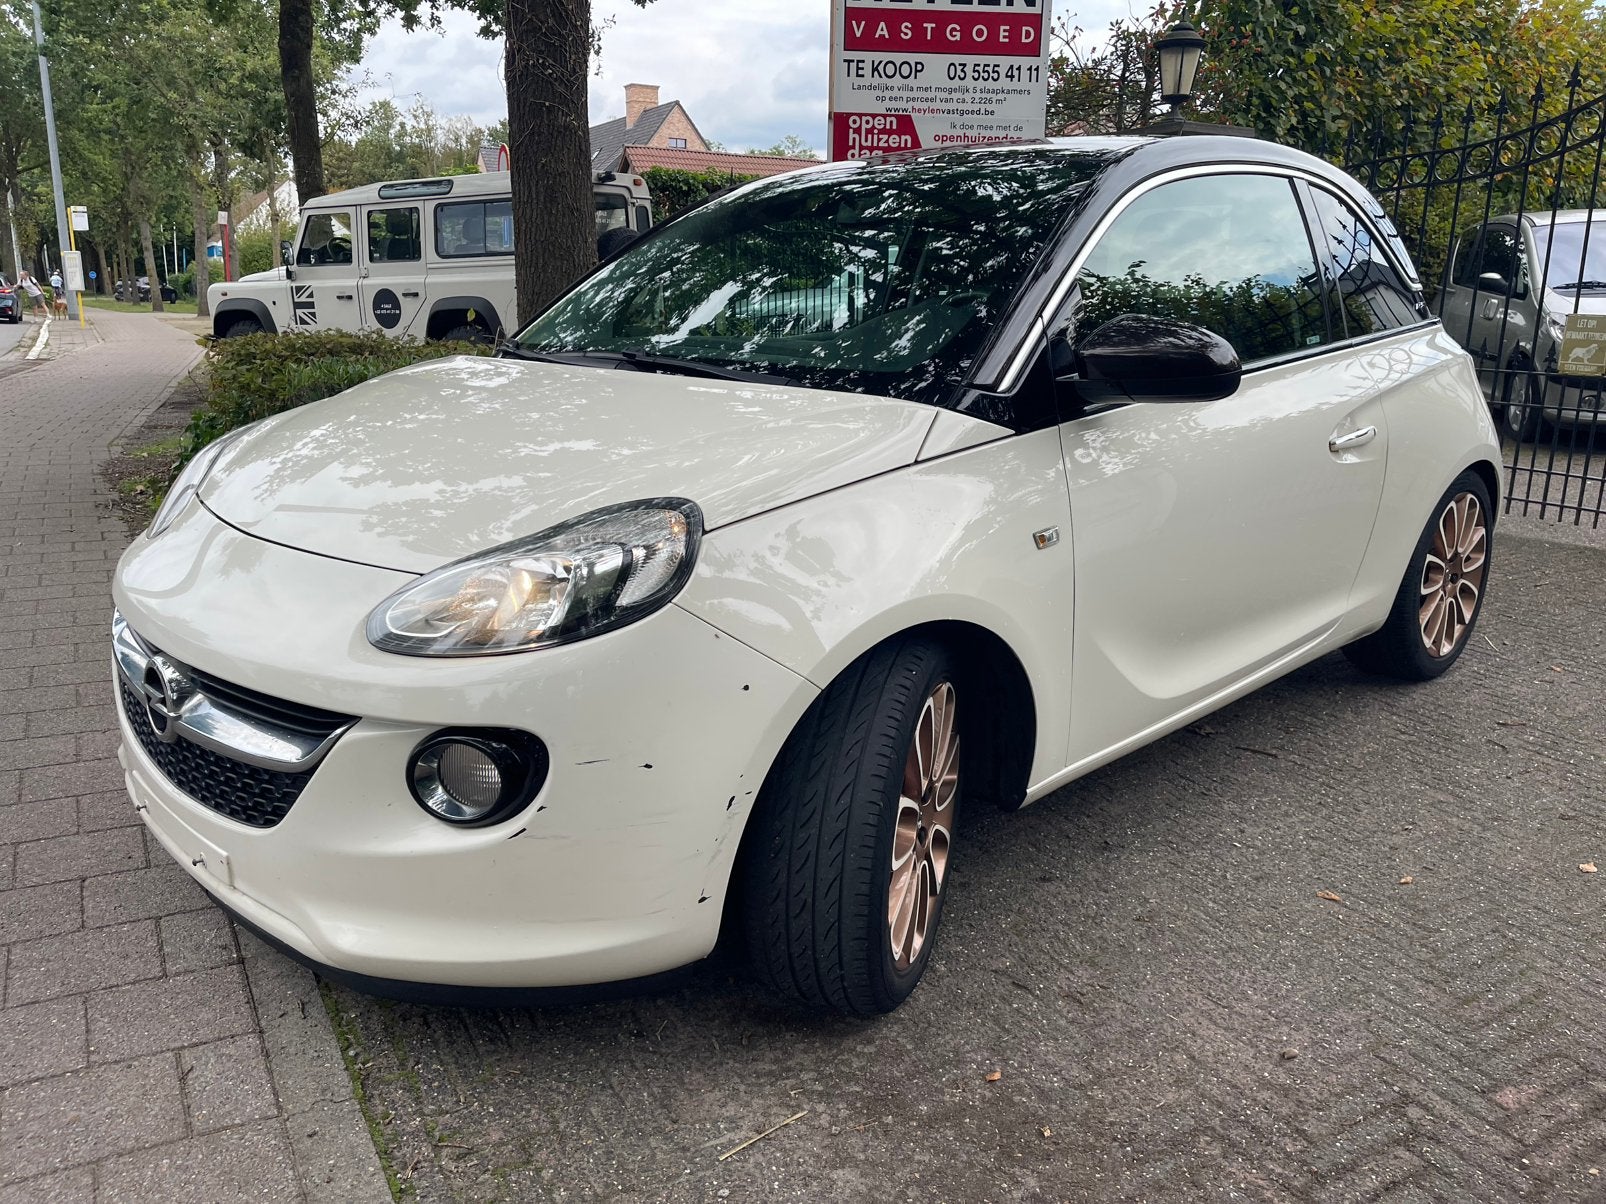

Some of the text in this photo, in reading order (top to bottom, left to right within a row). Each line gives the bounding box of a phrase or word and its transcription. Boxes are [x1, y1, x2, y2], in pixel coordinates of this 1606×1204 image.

[851, 20, 1035, 43] VASTGOED
[843, 59, 925, 80] TE KOOP
[947, 62, 1040, 83] 03 555 41 11
[852, 82, 1031, 97] Landelijke villa met mogelijk 5 slaapkamers
[875, 95, 887, 103] op
[905, 95, 937, 104] perceel
[970, 97, 993, 105] 2.226
[885, 105, 995, 117] www.heylenvastgoed.be
[848, 115, 897, 130] open
[950, 121, 1024, 132] Ik doe mee met de
[848, 128, 912, 148] huizen
[1577, 319, 1587, 328] LET
